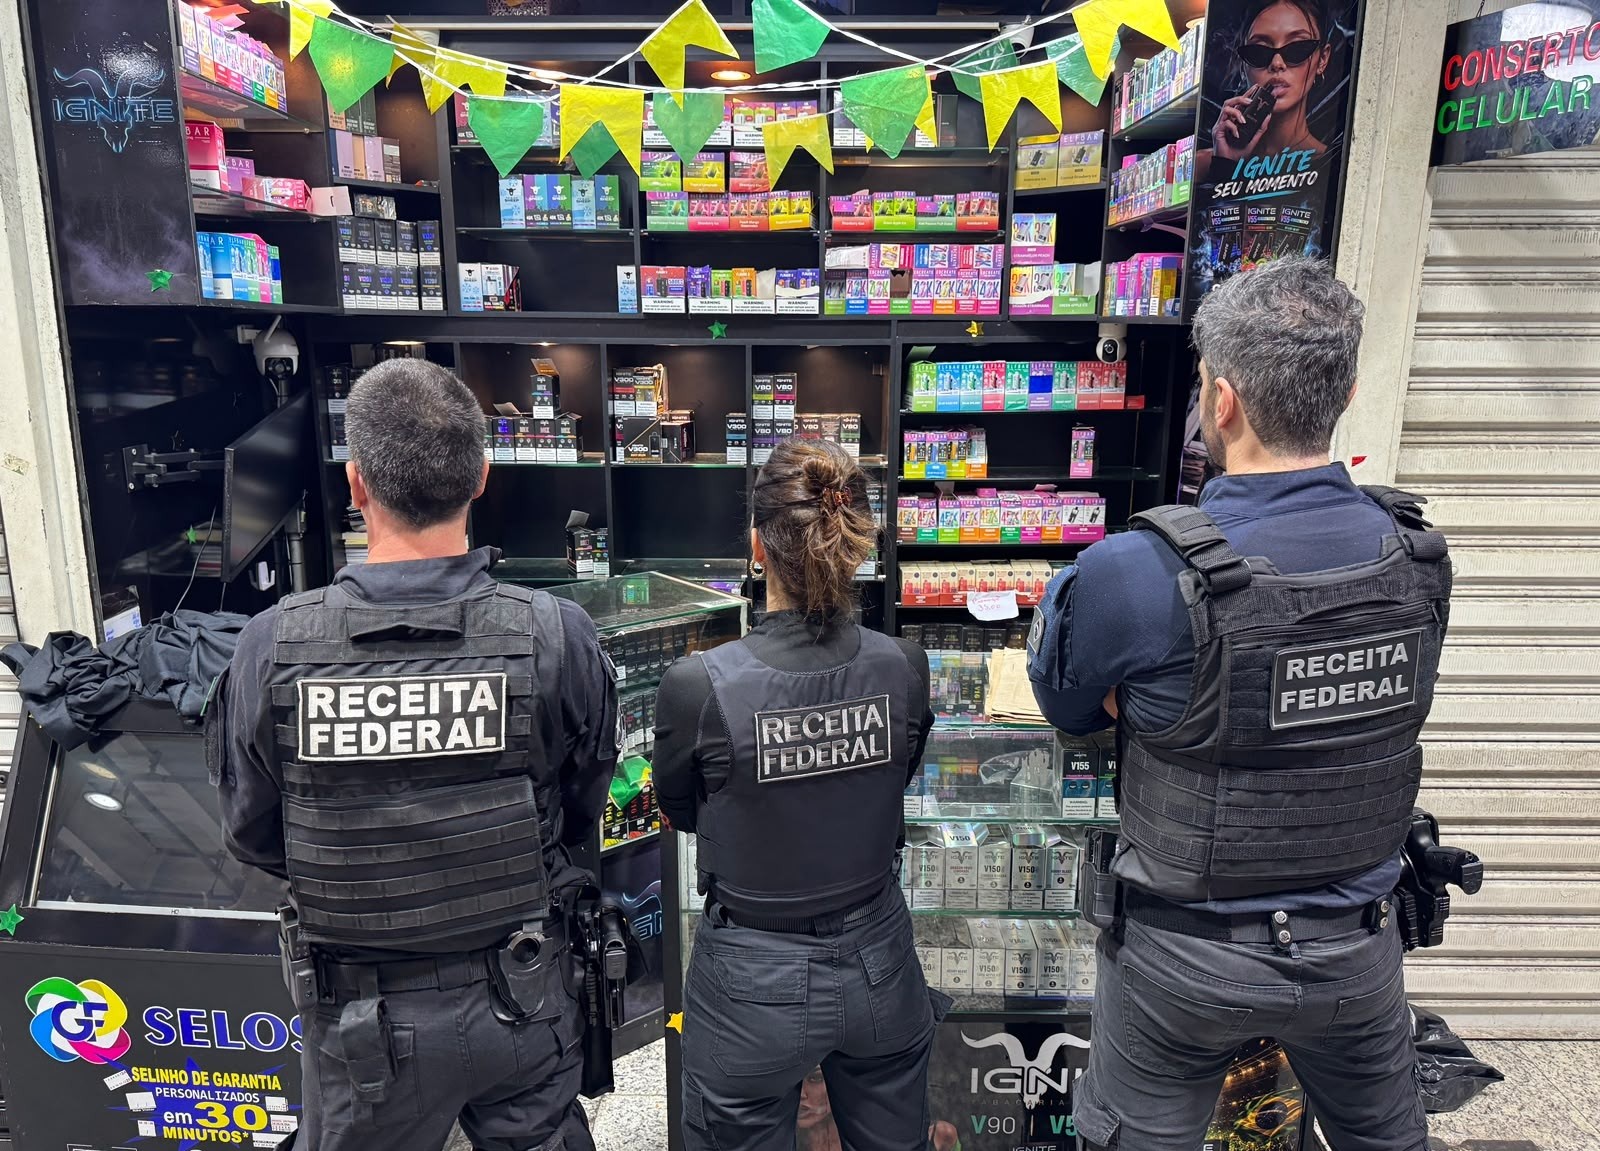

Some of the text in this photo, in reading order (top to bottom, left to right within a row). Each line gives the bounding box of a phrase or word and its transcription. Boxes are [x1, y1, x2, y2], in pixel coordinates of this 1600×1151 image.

[1444, 22, 1600, 91] CONSERTO
[52, 98, 175, 123] IGNITE
[1437, 75, 1594, 135] CELULAR
[1063, 133, 1099, 143] ELFBAR
[1212, 170, 1319, 199] SEU MOMENTO
[1210, 206, 1240, 217] IGNITE
[1247, 207, 1277, 216] IGNITE
[1281, 207, 1312, 219] IGNITE
[1286, 642, 1409, 681] RECEITA
[307, 680, 498, 719] RECEITA
[1280, 674, 1409, 713] FEDERAL
[309, 715, 497, 756] FEDERAL
[762, 703, 885, 745] RECEITA
[763, 733, 885, 776] FEDERAL
[1071, 762, 1090, 770] V155
[52, 1001, 108, 1042] GF
[143, 1006, 303, 1053] SELO
[130, 1066, 282, 1091] SELINHO DE GARANTIA
[155, 1087, 260, 1104] PERSONALIZADOS
[164, 1111, 192, 1124] em
[195, 1102, 268, 1131] 30
[970, 1114, 1016, 1134] V90
